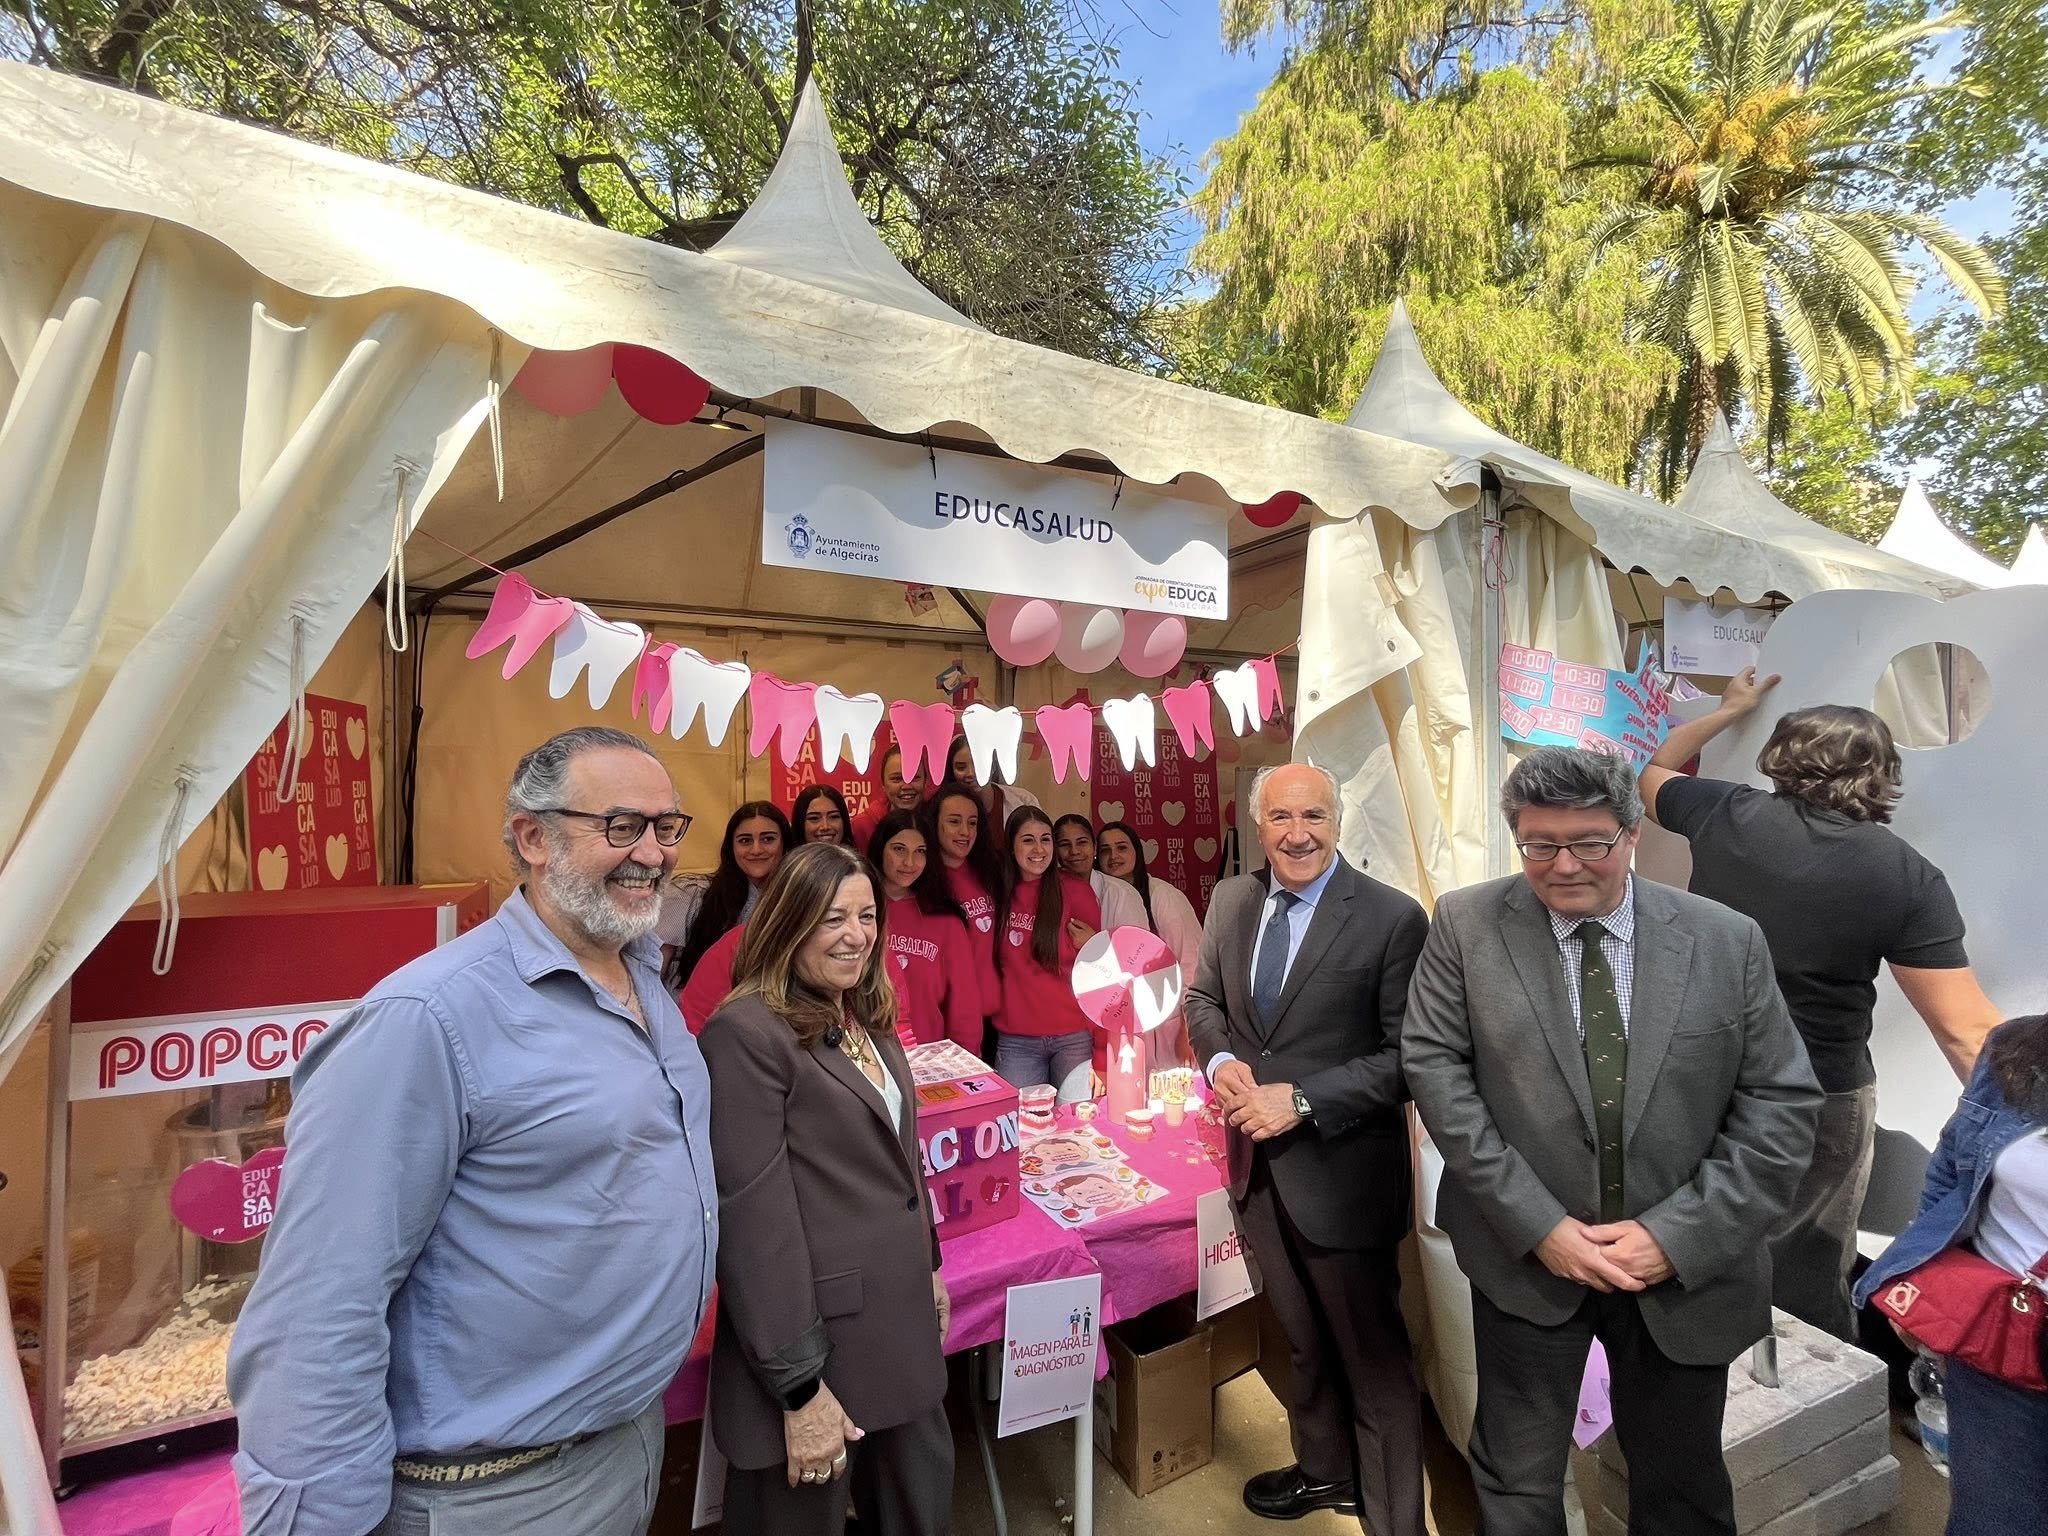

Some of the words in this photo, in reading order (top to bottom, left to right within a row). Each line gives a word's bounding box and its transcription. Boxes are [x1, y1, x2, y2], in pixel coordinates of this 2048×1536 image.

[935, 492, 1113, 543] EDUCASALUD
[815, 535, 880, 551] Ayuntamiento
[815, 547, 827, 555] de
[830, 547, 879, 562] Algeciras
[1168, 600, 1217, 613] ALGECIRAS
[1511, 650, 1545, 669] 10:00
[1506, 674, 1539, 695] 11:00
[1564, 668, 1601, 686] 10:30
[1562, 693, 1599, 712] 11:30
[321, 708, 337, 729] EDU
[1539, 713, 1576, 732] 12:30
[259, 733, 277, 754] A
[323, 730, 339, 757] CA
[1161, 735, 1178, 745] EDU
[1100, 743, 1118, 758] CA
[1162, 746, 1179, 760] CA
[257, 756, 278, 788] SA
[324, 758, 340, 785] SA
[1101, 760, 1119, 774] SA
[1163, 761, 1180, 775] SA
[1101, 776, 1119, 786] LUD
[1133, 772, 1152, 783] EDU
[1193, 773, 1210, 784] EDU
[296, 782, 314, 803] EDU
[325, 787, 342, 808] LUD
[352, 780, 367, 798] EDU
[842, 781, 871, 796] EDU
[1134, 783, 1152, 798] CA
[1194, 784, 1211, 798] CA
[354, 799, 368, 824] CA
[1136, 799, 1153, 813] SA
[1195, 799, 1212, 813] SA
[297, 804, 316, 833] CA
[1136, 815, 1154, 826] LUD
[1195, 814, 1213, 825] LUD
[355, 825, 370, 851] SA
[1166, 838, 1184, 849] EDU
[299, 834, 318, 865] SA
[1168, 849, 1185, 864] CA
[357, 851, 371, 872] LUD
[301, 865, 319, 889] LUD
[1169, 864, 1187, 880] SA
[1200, 875, 1216, 886] EDU
[887, 934, 938, 962] ASALUD
[242, 1167, 271, 1184] EDU
[243, 1180, 271, 1199] CA
[243, 1196, 272, 1215] SA
[244, 1212, 273, 1228] LUD
[1009, 1340, 1052, 1360] IMAGEN
[1082, 1334, 1093, 1347] EL
[1015, 1353, 1085, 1377] DIAGNÓSTICO
